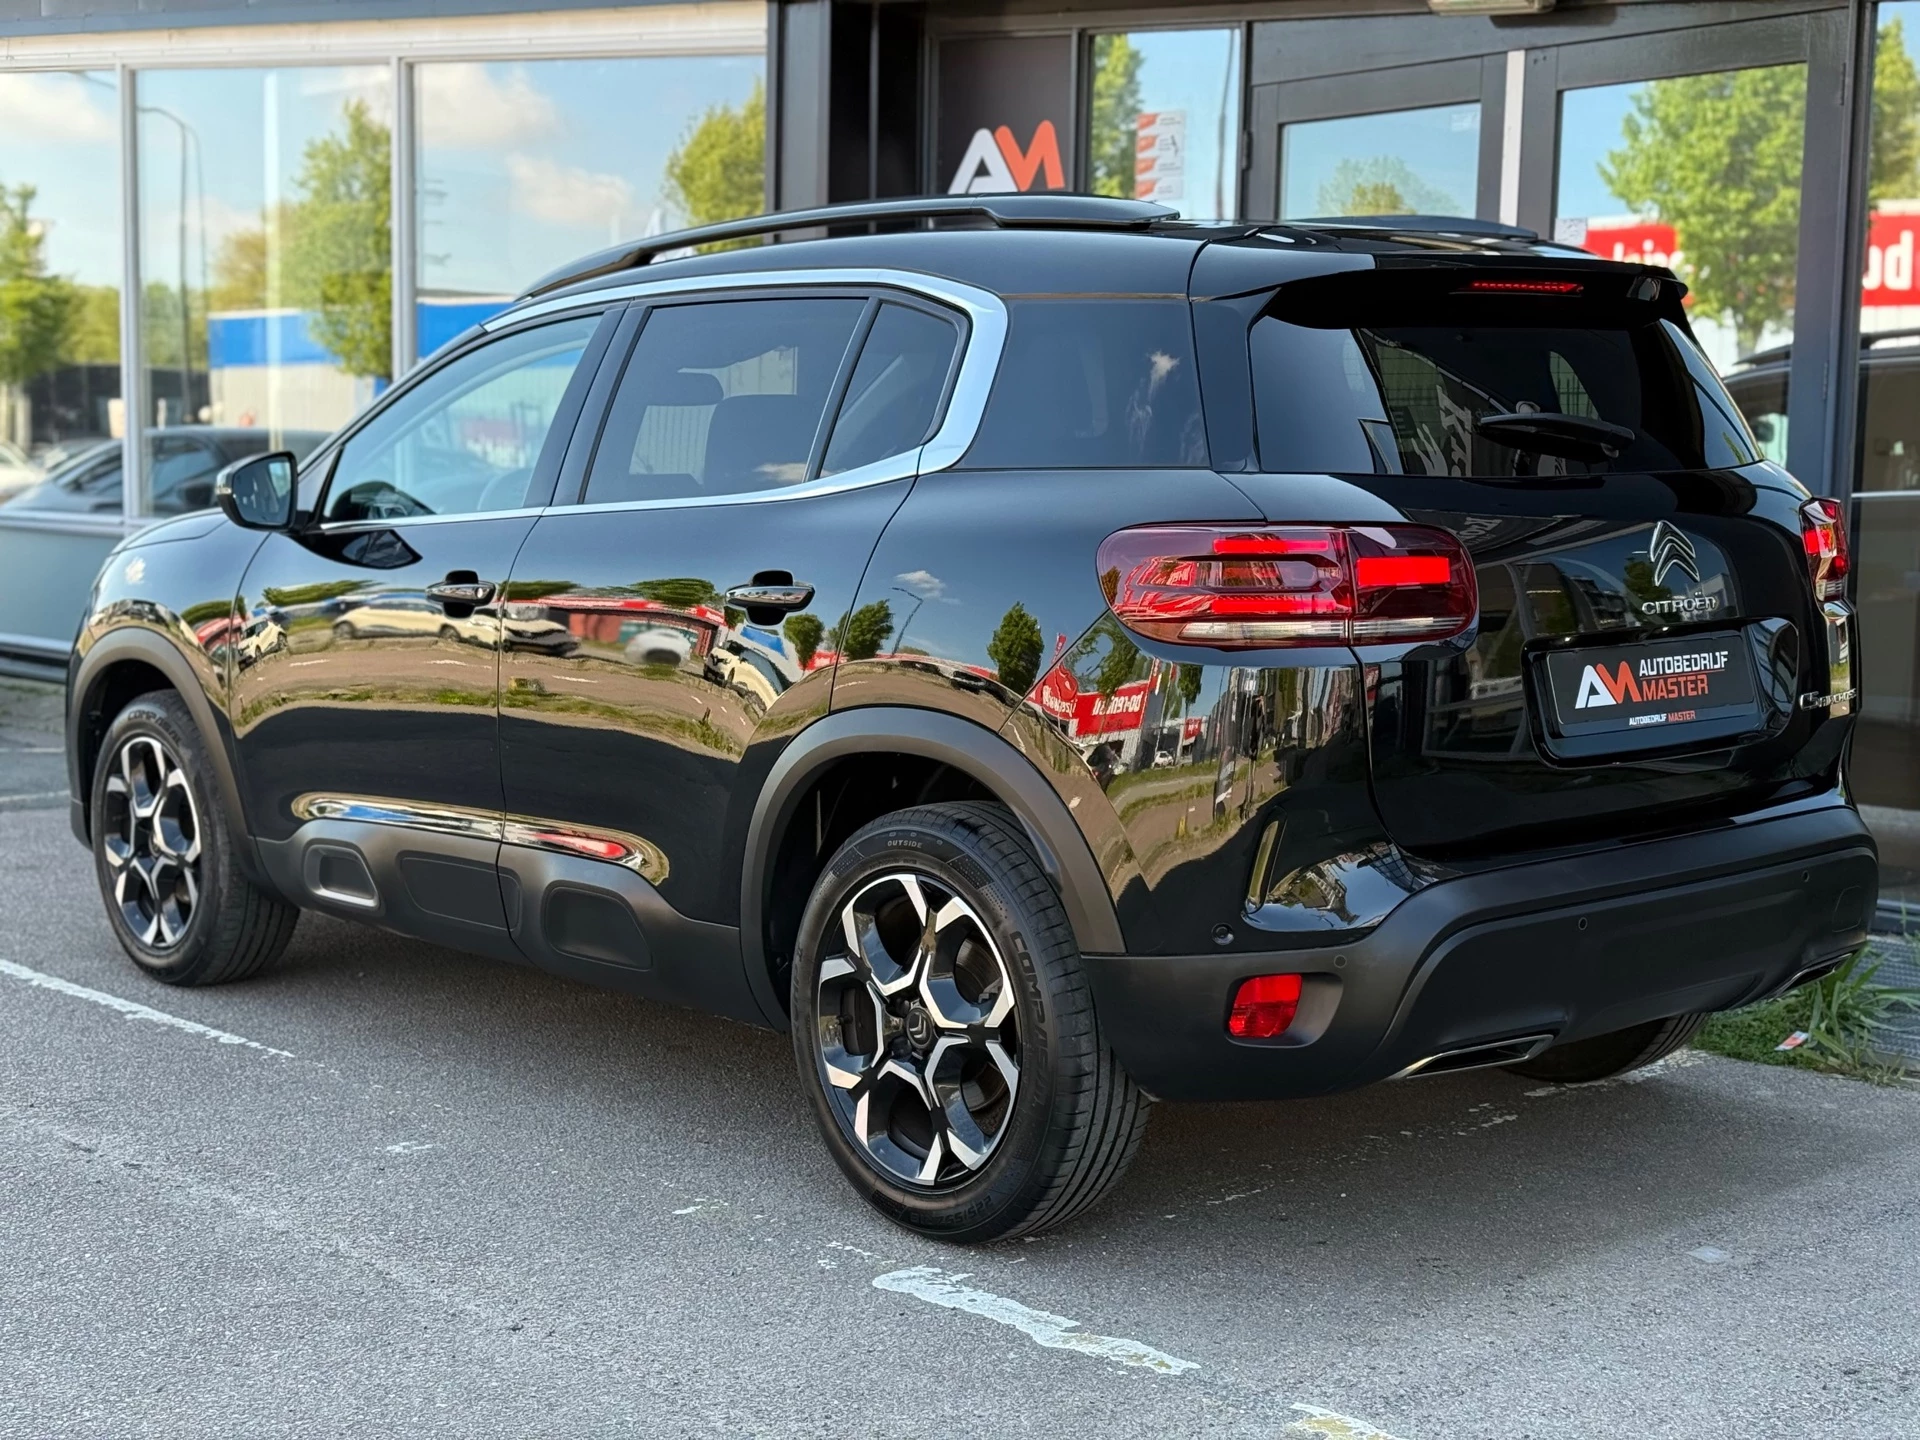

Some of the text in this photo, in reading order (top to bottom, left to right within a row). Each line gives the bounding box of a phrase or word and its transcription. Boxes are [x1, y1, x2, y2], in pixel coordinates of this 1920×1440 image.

[947, 119, 1065, 195] AM
[1641, 591, 1718, 615] CITROËN
[1638, 650, 1729, 677] AUTOBEDRIJF
[1575, 659, 1641, 710] AM
[1641, 674, 1709, 701] MASTER
[1629, 710, 1696, 726] AUTOBEDRIJF MASTER
[887, 839, 923, 849] OUTSIDE
